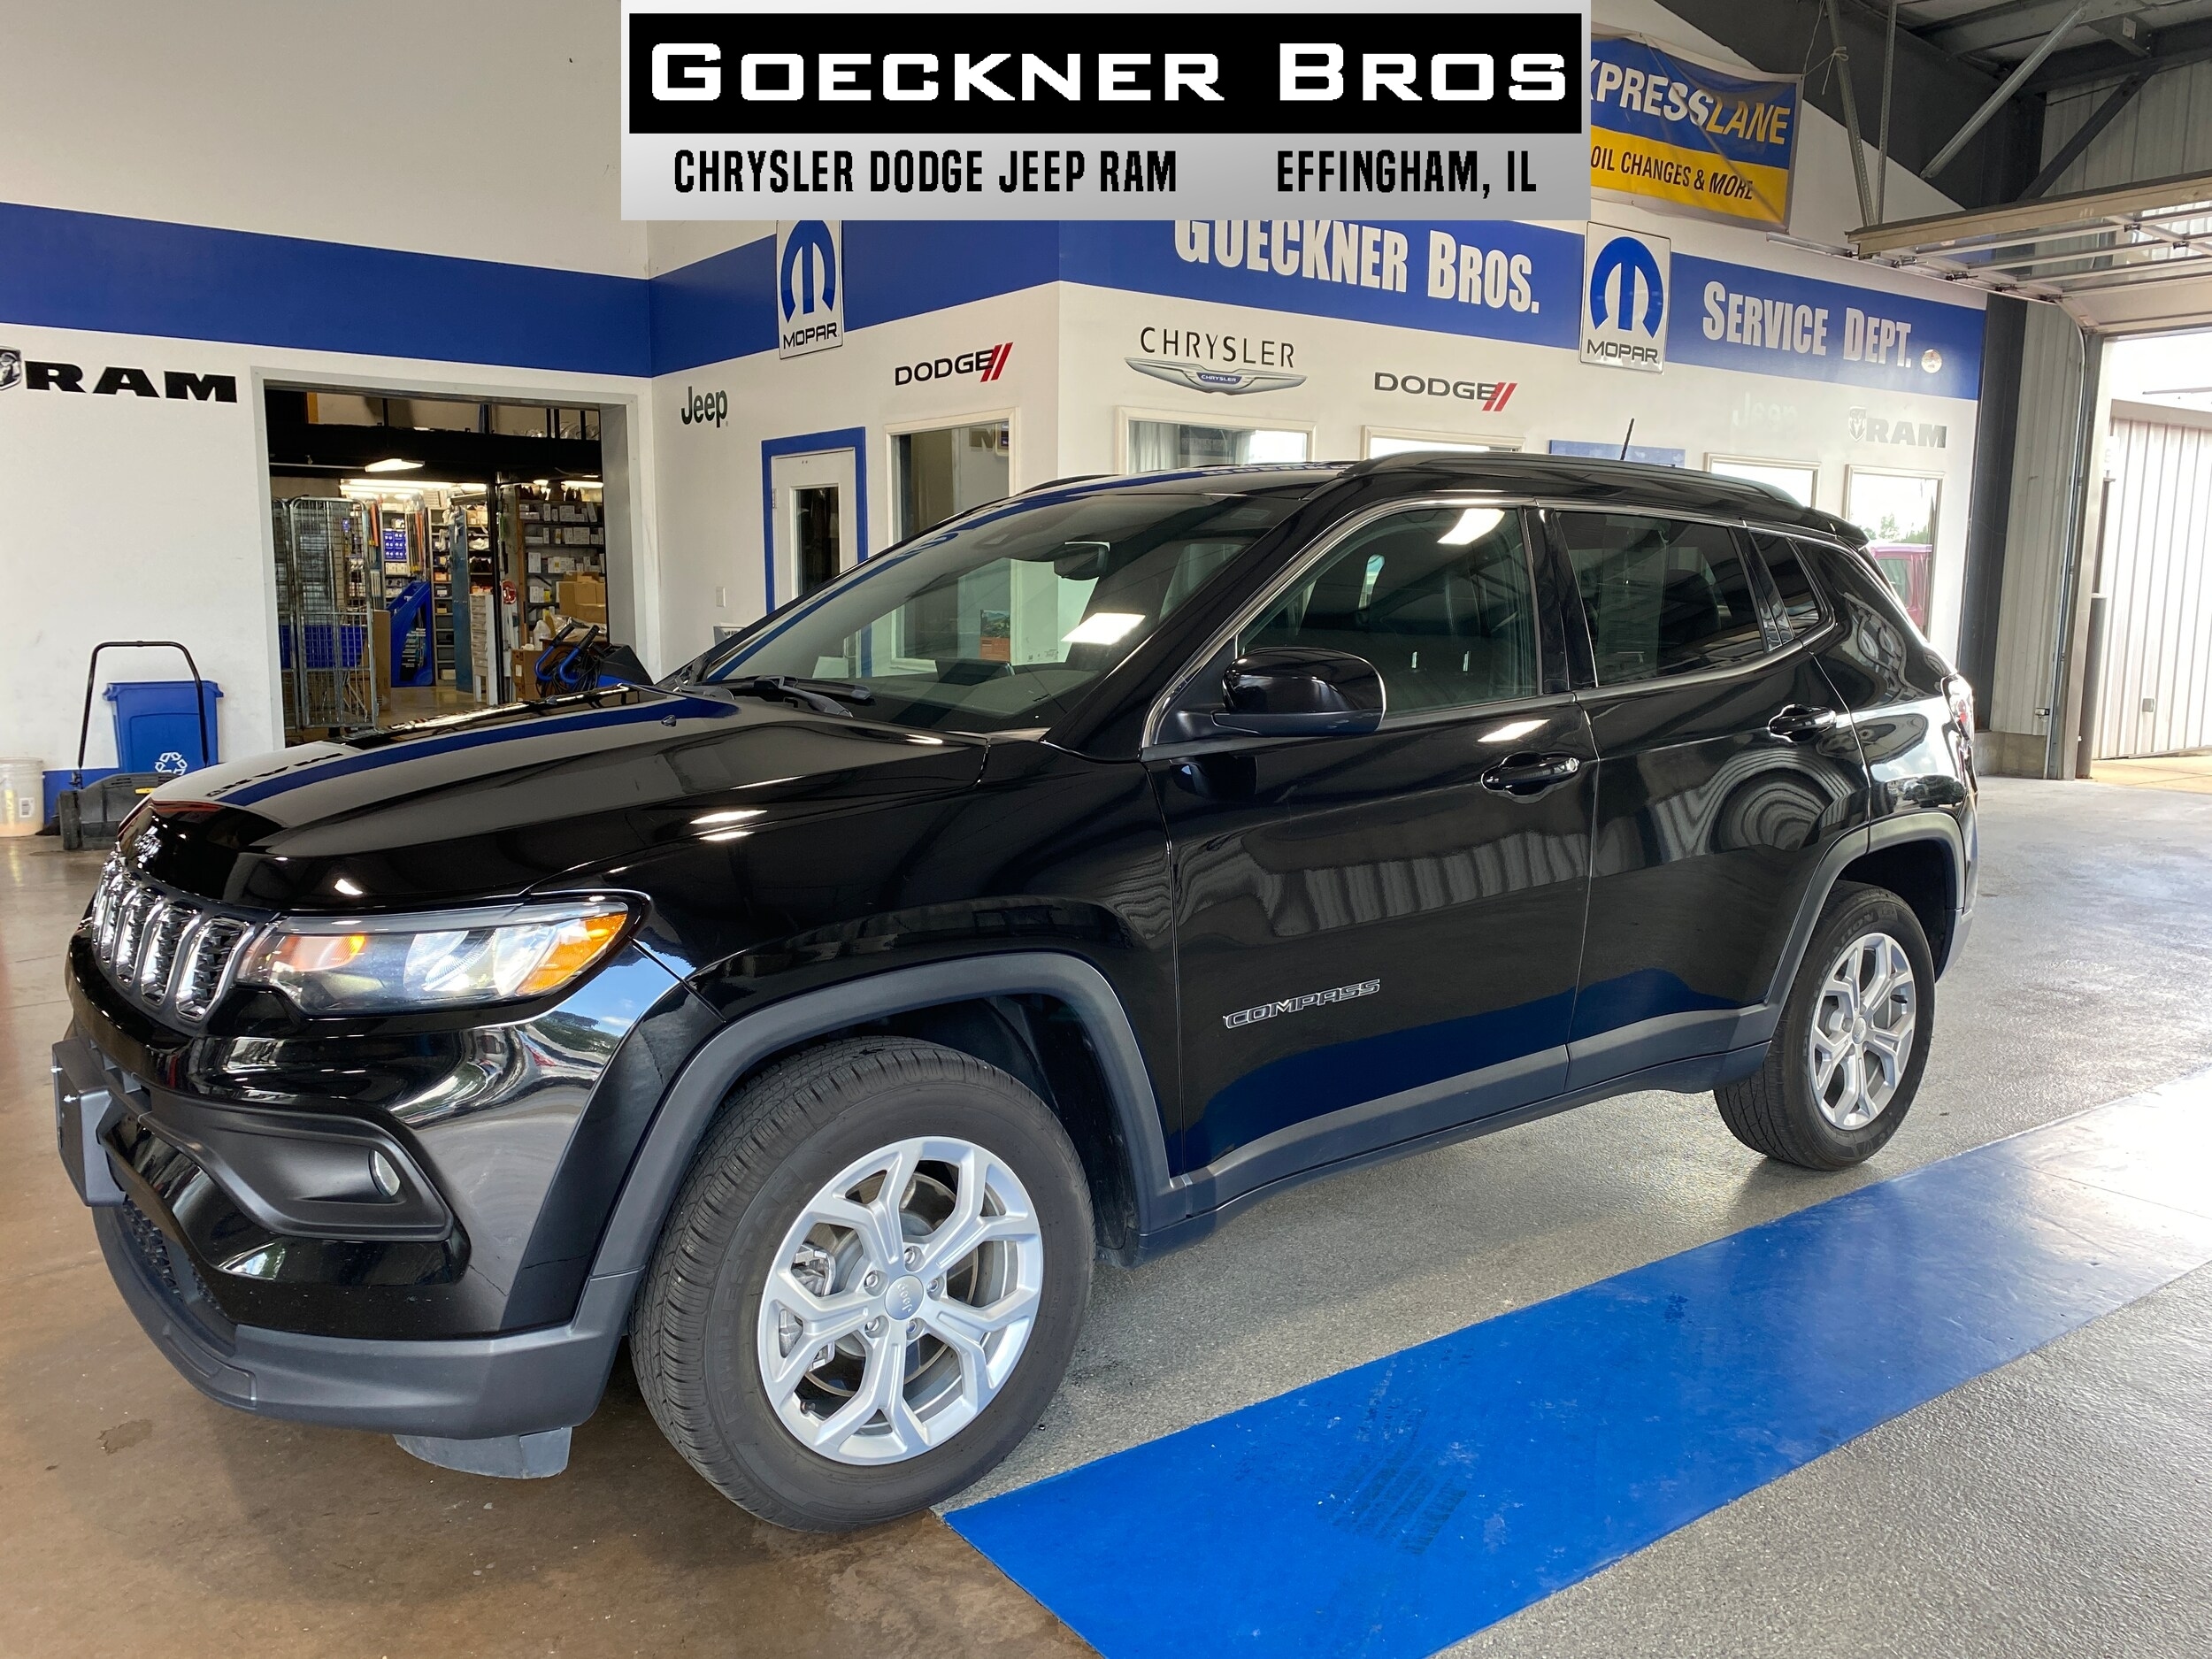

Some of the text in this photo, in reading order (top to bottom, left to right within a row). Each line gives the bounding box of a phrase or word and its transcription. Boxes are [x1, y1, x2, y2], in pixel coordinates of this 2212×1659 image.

[1591, 58, 1791, 145] PRESSLANE
[1591, 145, 1754, 200] OIL CHANGES & MORE
[1427, 229, 1540, 314] BROS.
[783, 321, 838, 349] MOPAR
[1702, 280, 1912, 368] SERVICE DEPT.
[895, 349, 994, 386] DODGE
[1140, 326, 1294, 368] CHRYSLER
[1586, 339, 1658, 364] MOPAR
[24, 361, 237, 403] RAM
[1201, 373, 1237, 383] CHRYSLER
[1374, 372, 1498, 401] DODGE
[681, 386, 728, 428] Jeep
[1866, 418, 1947, 449] RAM
[1223, 979, 1380, 1029] COMPASS
